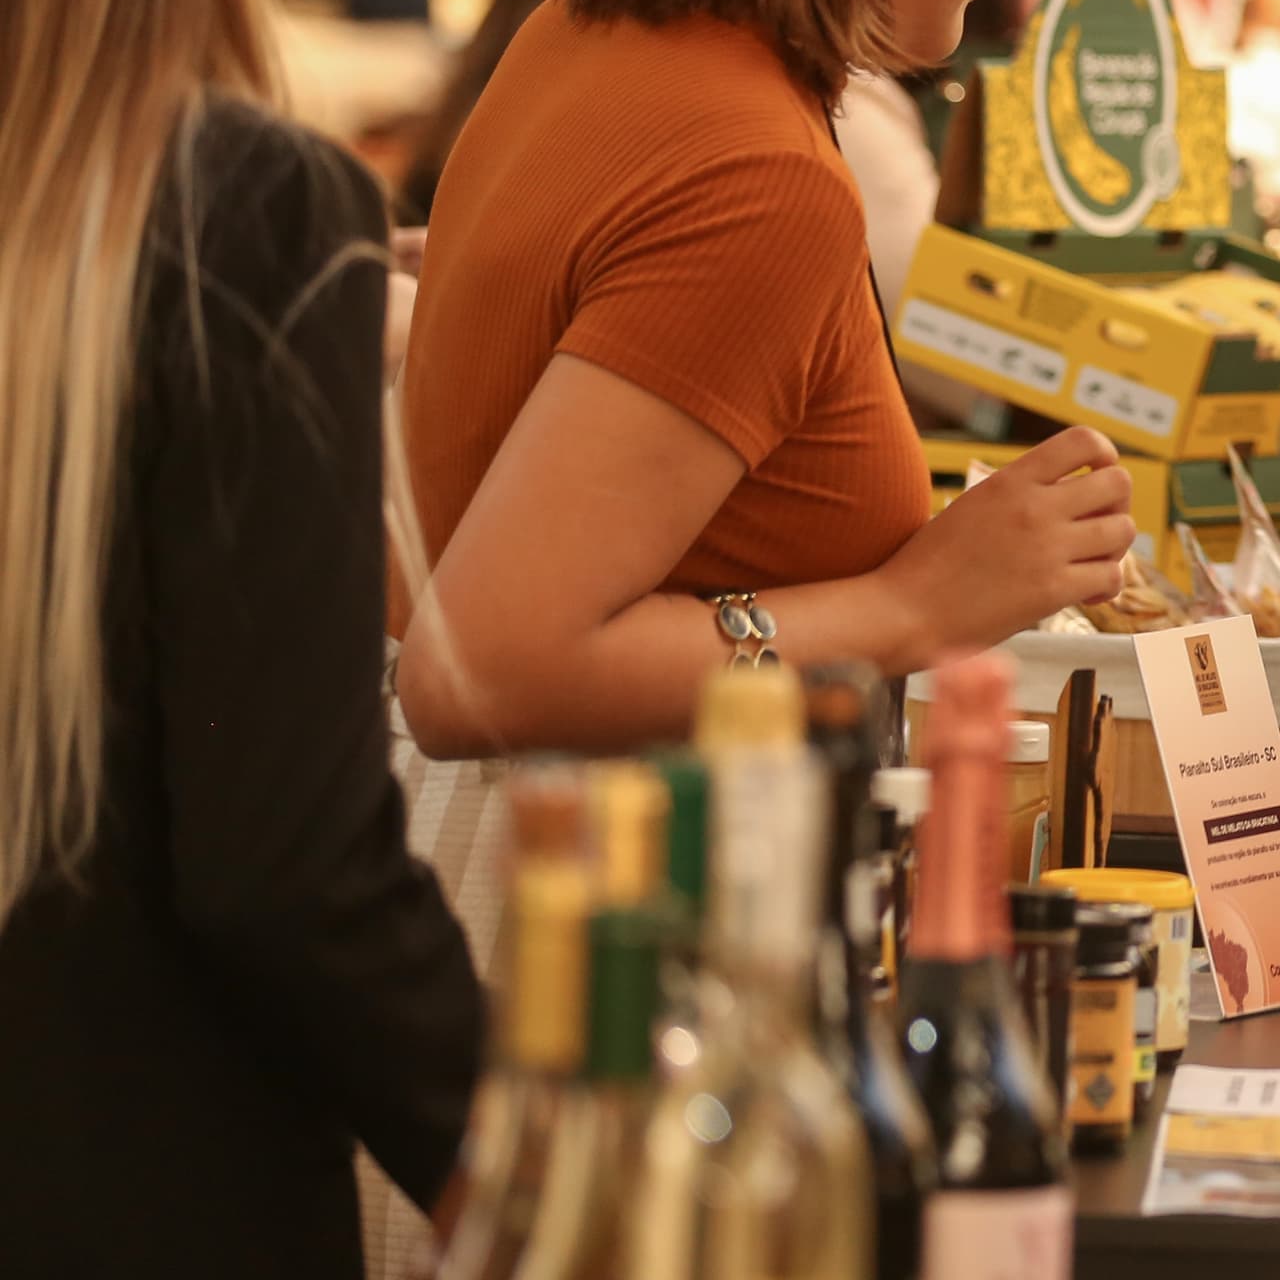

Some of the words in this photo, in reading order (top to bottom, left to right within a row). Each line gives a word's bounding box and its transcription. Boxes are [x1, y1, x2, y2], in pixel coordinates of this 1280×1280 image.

[1178, 760, 1211, 777] Planalto
[1210, 757, 1224, 772] Sul
[1224, 751, 1260, 769] Brasileiro
[1264, 746, 1277, 762] SC
